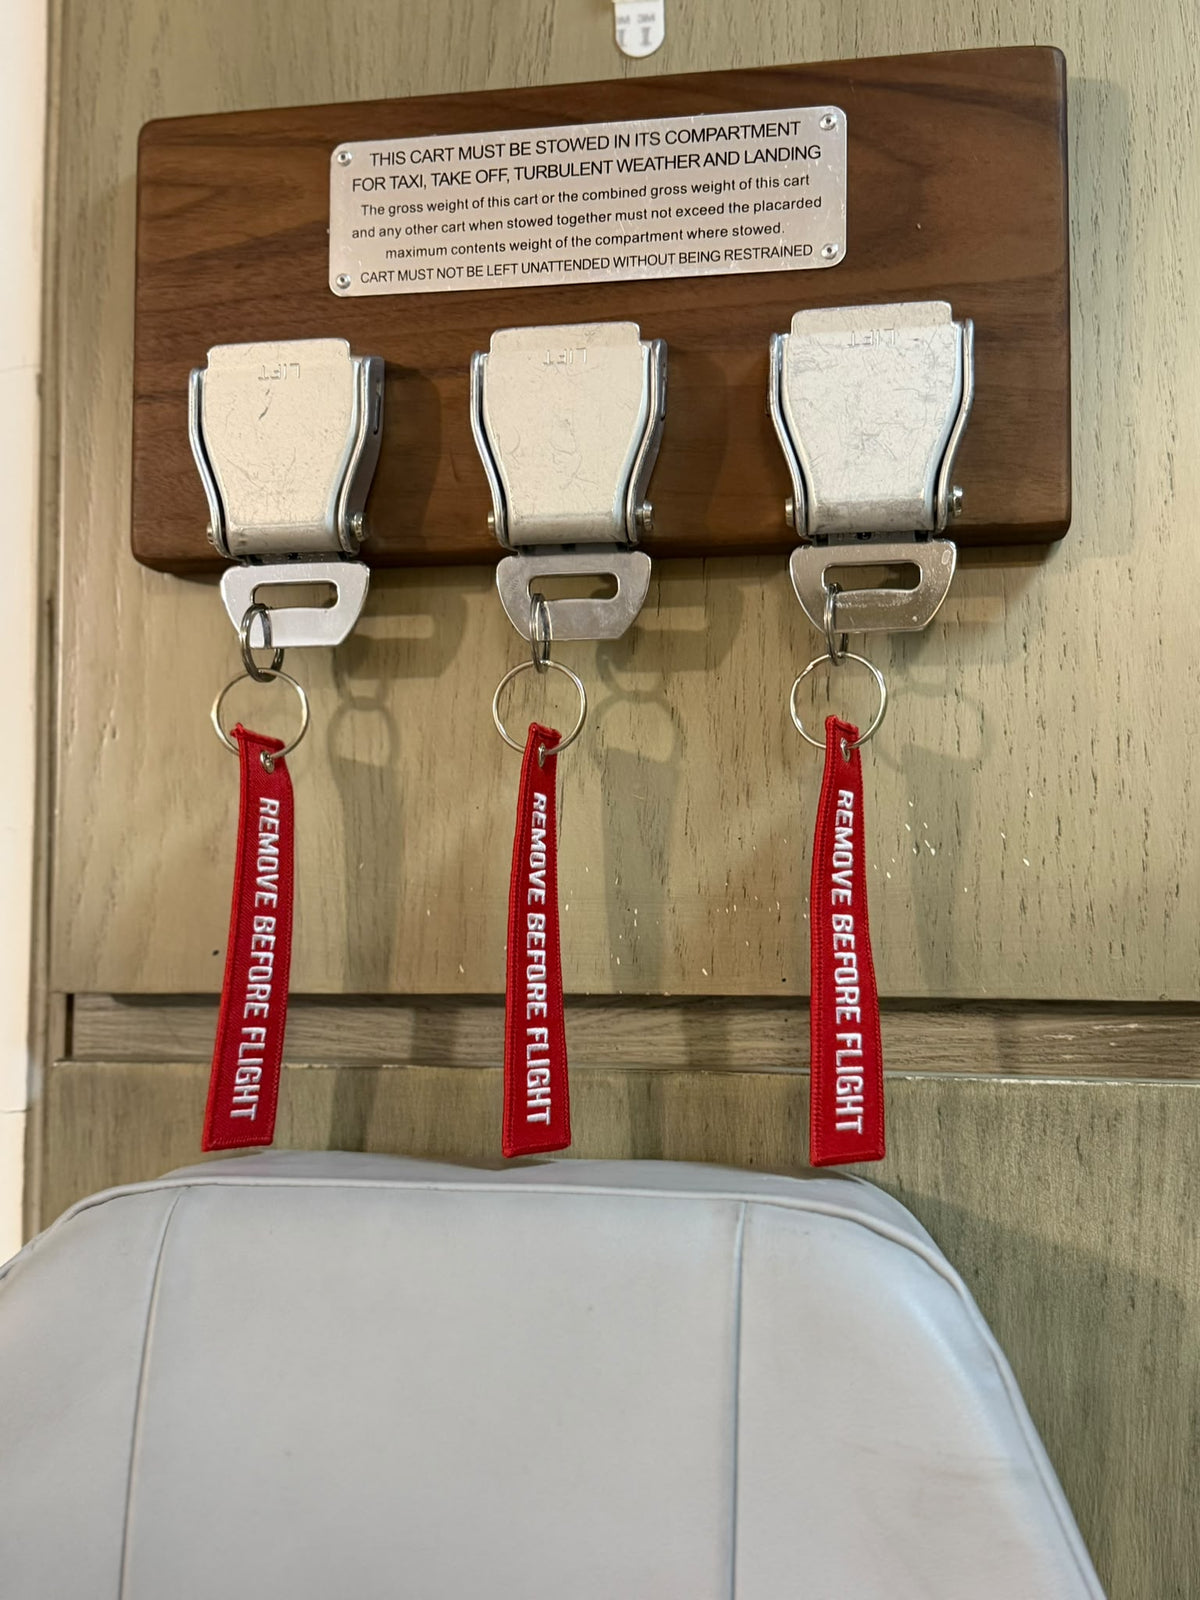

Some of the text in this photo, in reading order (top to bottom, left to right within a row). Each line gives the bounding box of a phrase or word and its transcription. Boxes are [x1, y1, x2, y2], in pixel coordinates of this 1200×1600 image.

[370, 121, 801, 167] THIS CART MUST BE STOWED IN ITS COMPARTMENT
[353, 145, 821, 192] FOR TAXI, TAKE OFF, TURBULENT WEATHER AND LANDING
[361, 174, 809, 217] The gross weight of this cart or the combined gross weight of this cart
[352, 196, 821, 239] and any other cart when stowed together must not exceed the placarded
[386, 222, 784, 259] maximum contents weight of the compartment where stowed.
[361, 244, 813, 283] CART MUST NOT BE LEFT UNATTENDED WITHOUT BEING RESTRAINED
[541, 347, 587, 365] LIFT
[847, 328, 895, 348] LIFT
[257, 362, 301, 380] LIFT
[231, 797, 279, 1120] REMOVE BEFORE FLIGHT
[527, 792, 551, 1125] REMOVE BEFORE FLIGHT
[831, 790, 863, 1134] REMOVE BEFORE FLIGHT
